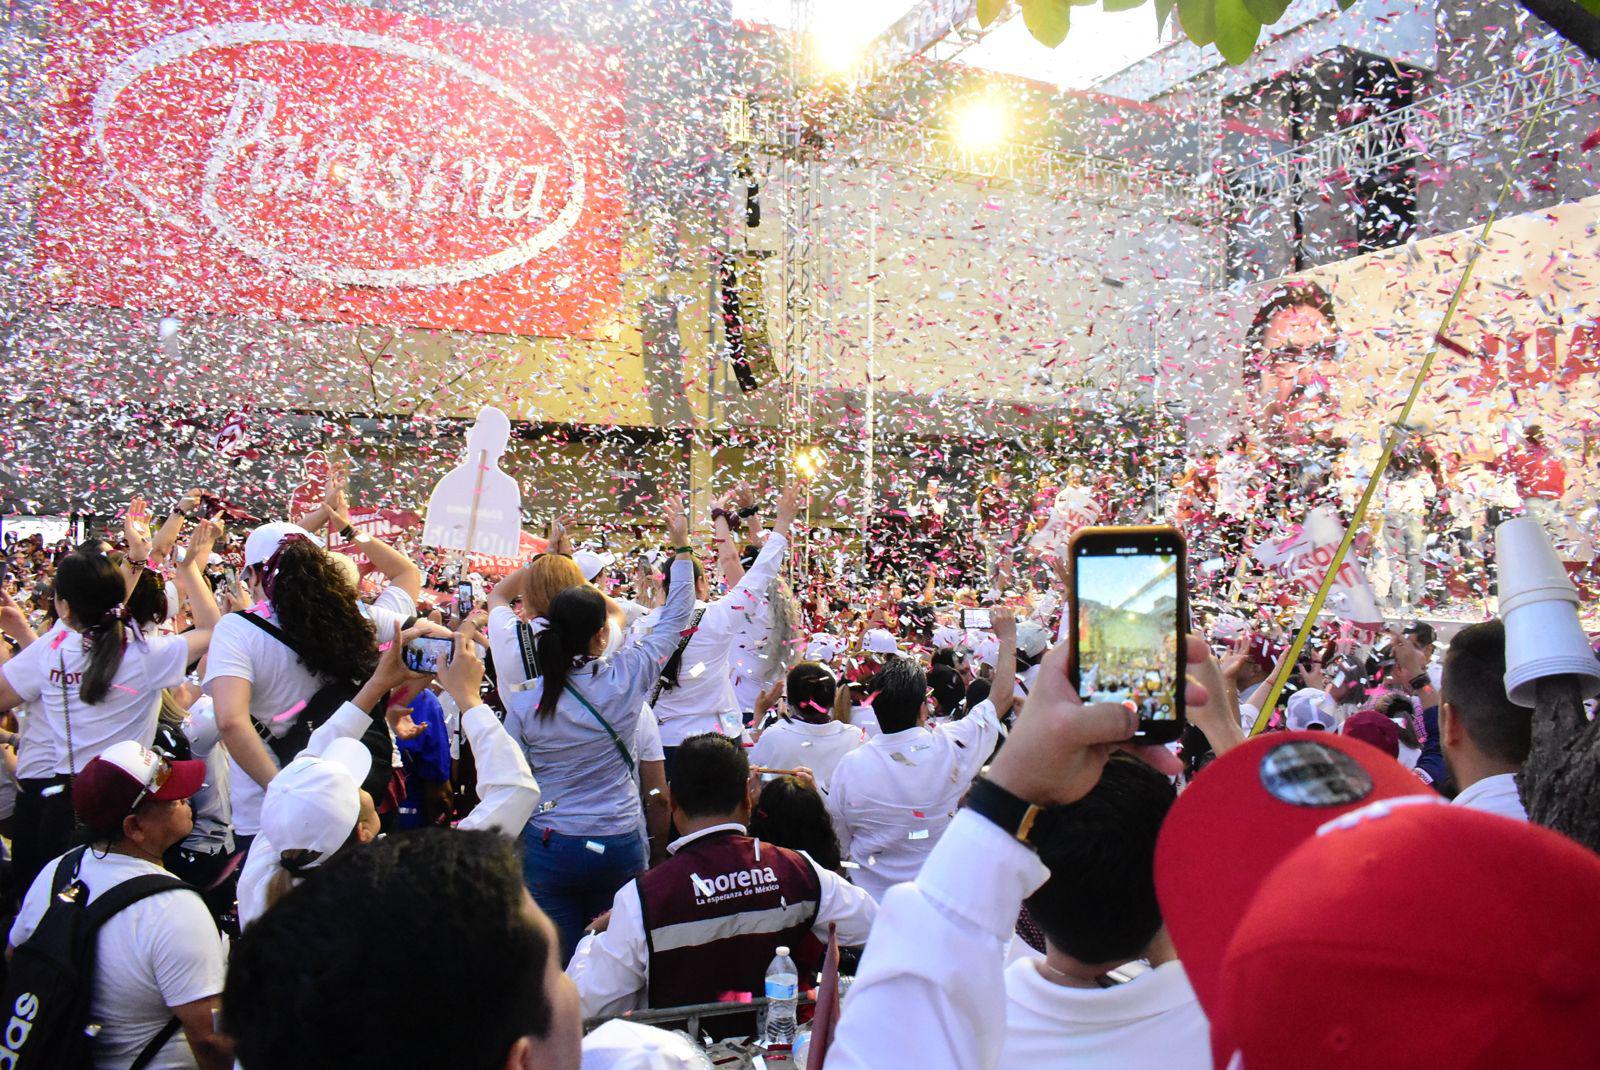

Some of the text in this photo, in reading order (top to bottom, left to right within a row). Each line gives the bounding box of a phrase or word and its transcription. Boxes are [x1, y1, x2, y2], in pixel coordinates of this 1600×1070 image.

[696, 882, 780, 905] La esperanza de México
